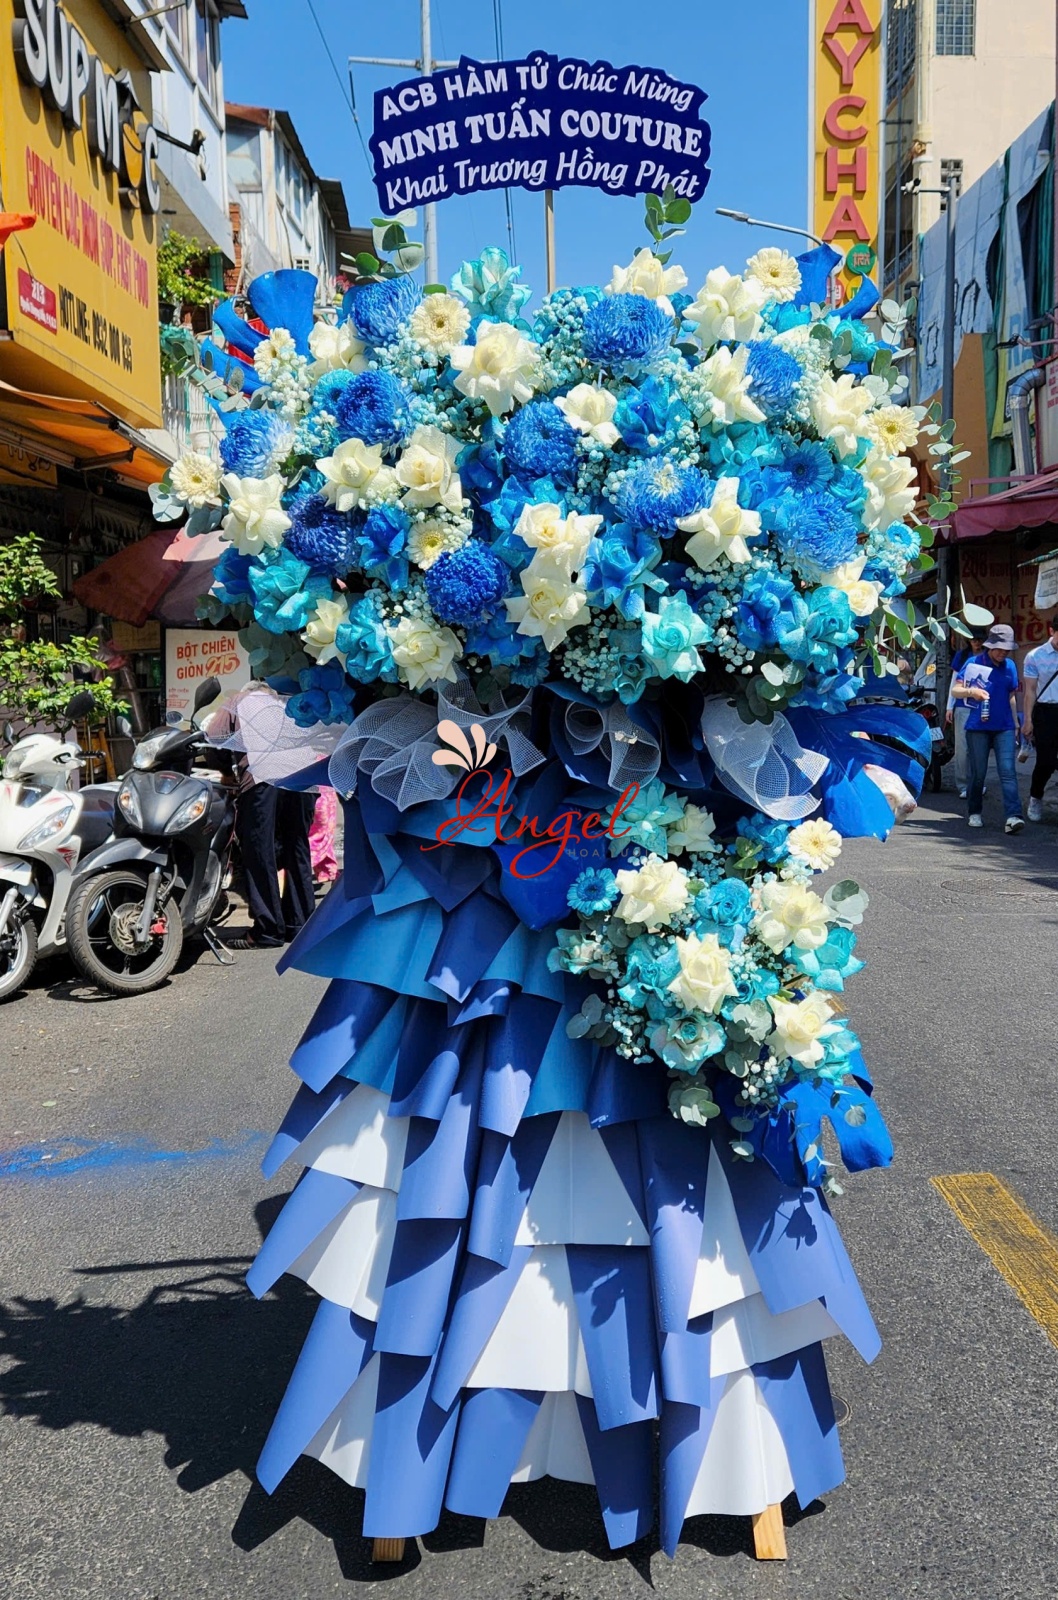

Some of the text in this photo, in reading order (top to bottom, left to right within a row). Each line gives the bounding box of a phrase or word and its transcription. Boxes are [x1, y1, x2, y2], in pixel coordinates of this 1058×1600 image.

[381, 56, 695, 120] ACB HÀM TỬ Chúc Mừng
[378, 97, 703, 169] MINH TUẤN COUTURE
[385, 146, 700, 210] Khai Trương Hồng Phát
[176, 635, 236, 661] BỘT CHIÊN
[205, 652, 241, 678] 215
